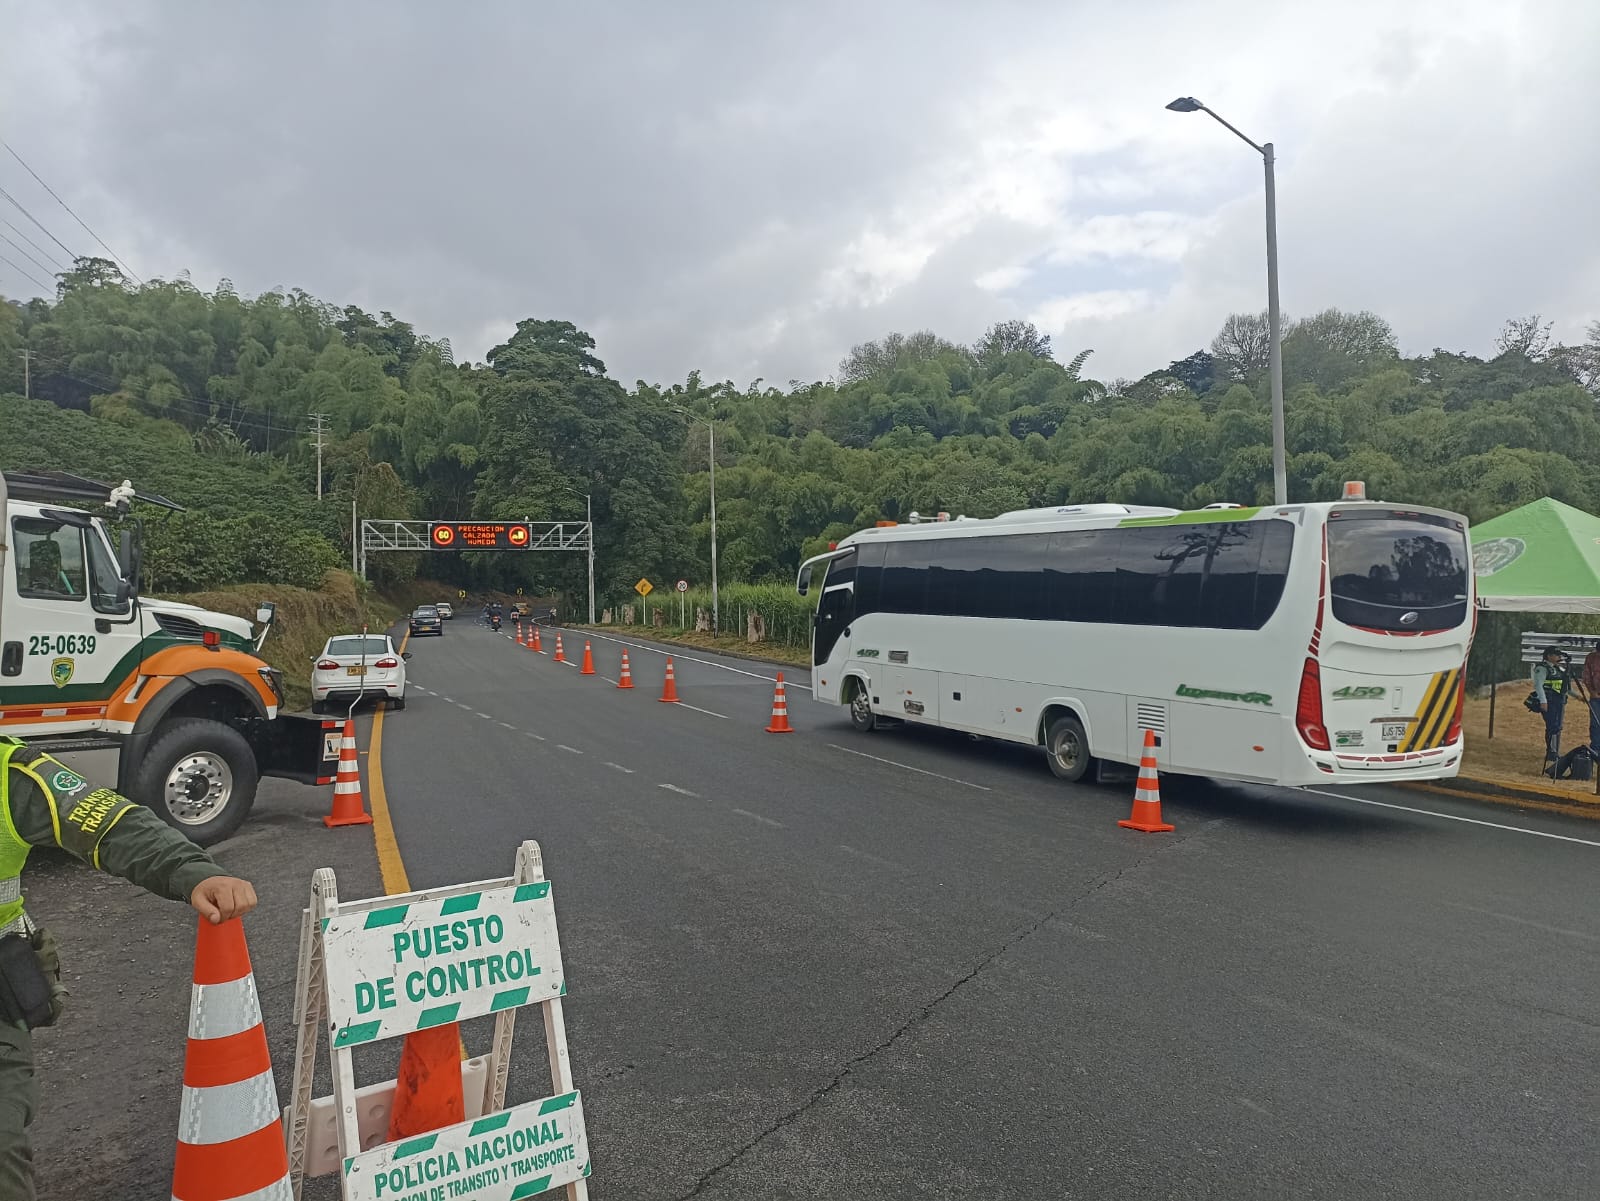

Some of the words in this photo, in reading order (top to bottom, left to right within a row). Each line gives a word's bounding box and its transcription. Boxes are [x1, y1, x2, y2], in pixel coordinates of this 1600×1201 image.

[28, 635, 96, 656] 25-0639
[1332, 686, 1386, 698] 459
[393, 913, 504, 963] PUESTO
[354, 976, 397, 1015] DE
[405, 947, 541, 1003] CONTROL
[374, 1150, 458, 1198] POLICIA
[464, 1119, 564, 1169] NACIONAL
[430, 1184, 446, 1201] DE
[447, 1167, 500, 1199] TRANSITO
[501, 1163, 509, 1180] Y
[511, 1144, 576, 1178] TRANSPORTE
